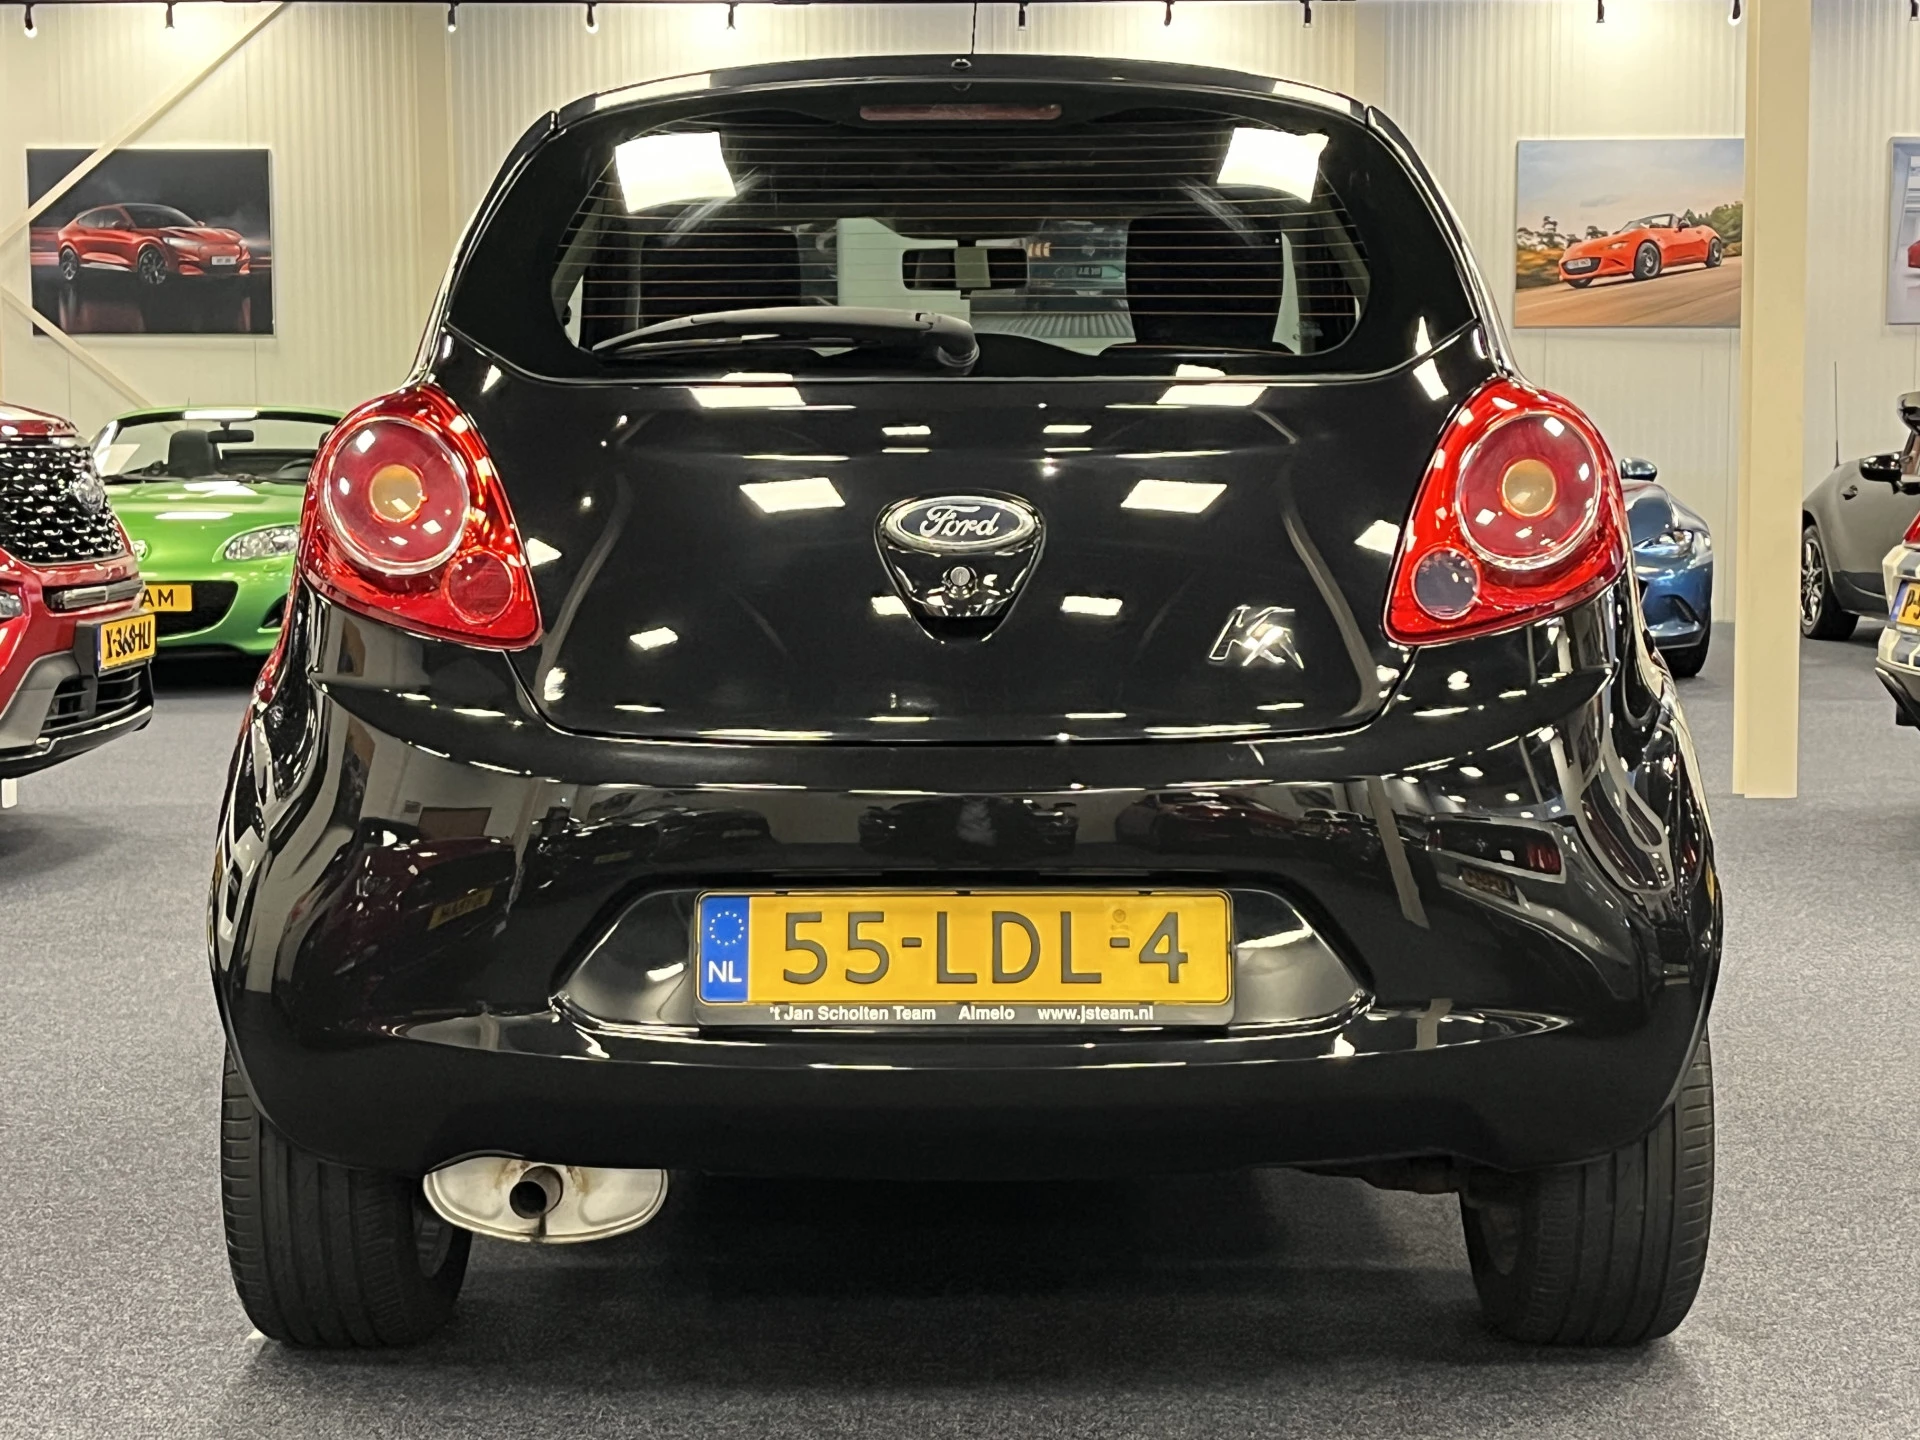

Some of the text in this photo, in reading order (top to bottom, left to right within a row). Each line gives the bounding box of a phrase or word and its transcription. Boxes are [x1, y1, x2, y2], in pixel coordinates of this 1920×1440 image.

[919, 505, 1001, 537] Ford
[783, 911, 1188, 985] 55-LDL-4
[708, 960, 742, 983] NL
[784, 1006, 814, 1021] Jan
[817, 1006, 890, 1021] Scholten
[893, 1006, 936, 1021] Team
[958, 1005, 1015, 1020] Almelo
[1037, 1005, 1154, 1023] www.jsteam.nl
